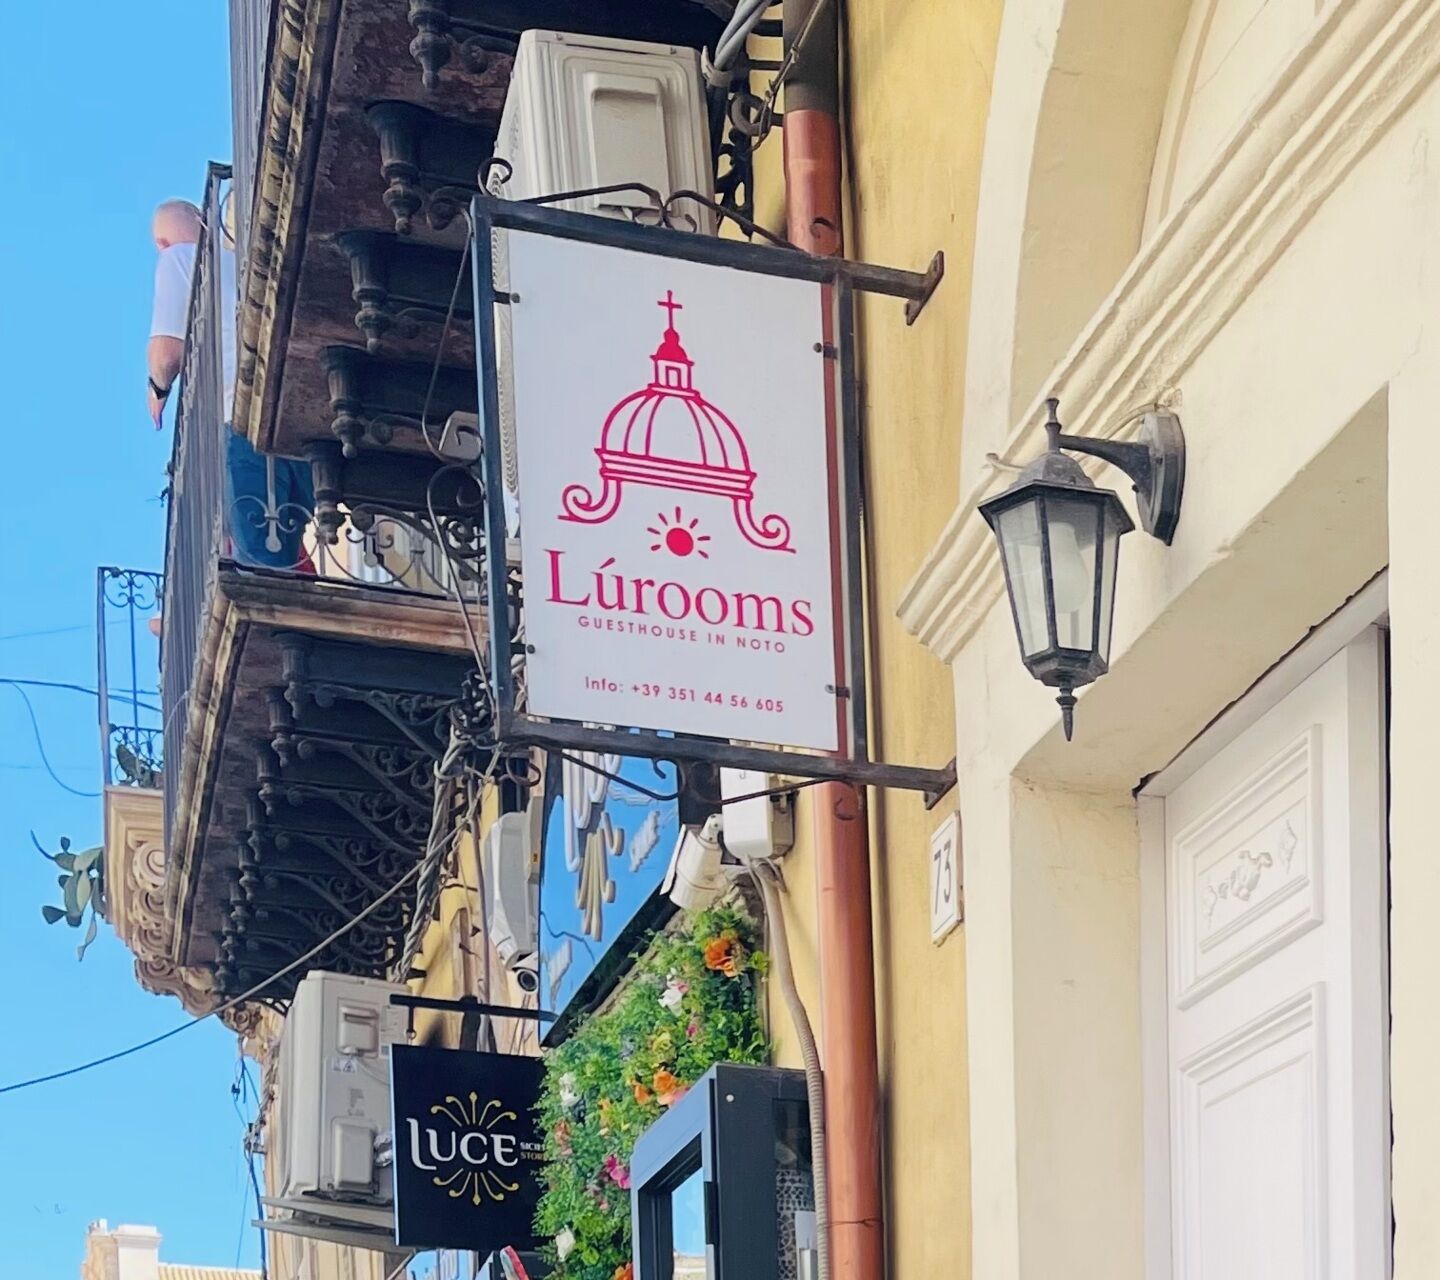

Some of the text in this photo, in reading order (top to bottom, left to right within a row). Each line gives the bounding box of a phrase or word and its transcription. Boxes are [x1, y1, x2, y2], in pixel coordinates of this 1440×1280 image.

[543, 549, 815, 637] Lúrooms
[578, 615, 785, 653] GUESTHOUSE IN NOTO
[632, 684, 660, 697] +39
[668, 687, 696, 702] 351
[704, 691, 723, 705] 44
[730, 695, 748, 708] 56
[755, 699, 784, 713] 605
